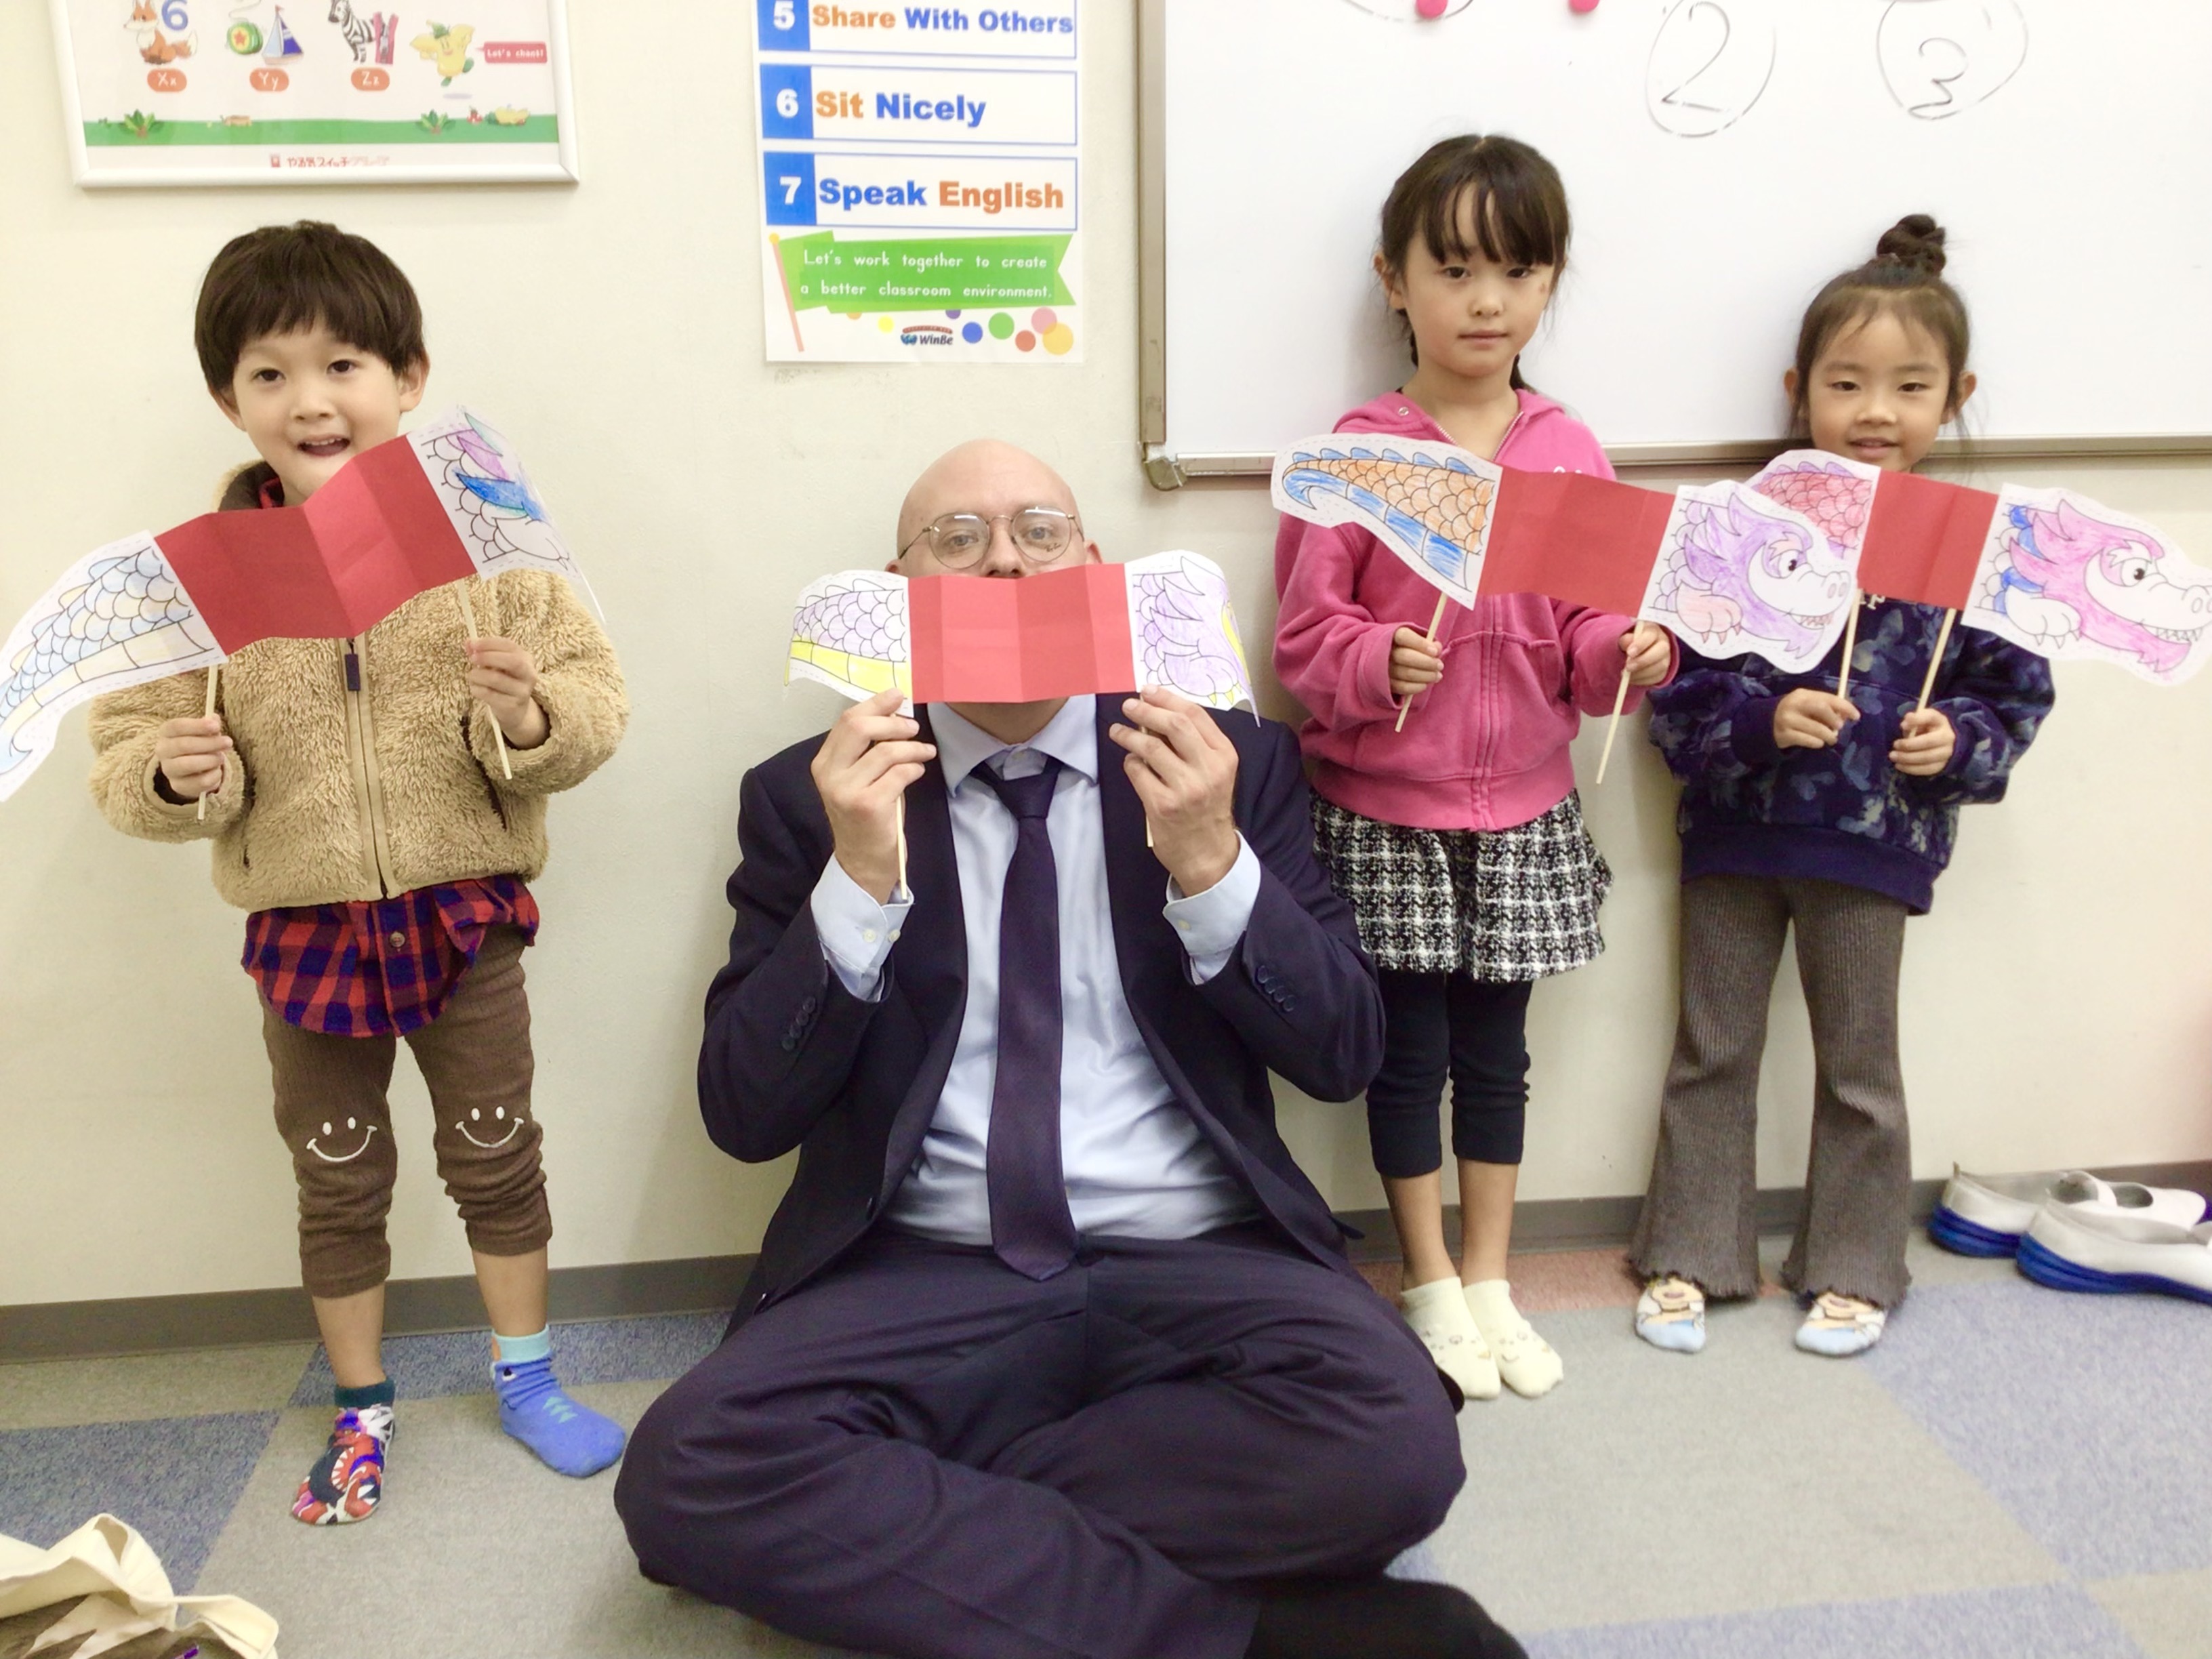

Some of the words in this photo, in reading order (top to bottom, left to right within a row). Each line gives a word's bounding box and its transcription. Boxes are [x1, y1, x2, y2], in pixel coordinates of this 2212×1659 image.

[773, 0, 796, 30] 5
[812, 4, 896, 29] Share
[904, 7, 969, 31] With
[979, 9, 1074, 34] Others
[157, 71, 178, 87] Xx
[258, 70, 279, 91] Yy
[361, 70, 380, 86] Zz
[775, 88, 800, 119] 6
[815, 90, 864, 119] Sit
[876, 92, 987, 128] Nicely
[779, 176, 802, 205] 7
[819, 178, 928, 211] Speak
[939, 180, 1064, 214] English
[804, 249, 842, 266] Let's
[853, 251, 890, 266] work
[902, 253, 964, 272] together
[975, 254, 990, 268] to
[1002, 255, 1048, 269] create
[800, 283, 809, 295] a
[821, 279, 867, 295] better
[878, 281, 951, 297] classroom
[962, 283, 1052, 298] environment.
[919, 334, 954, 346] WinBe
